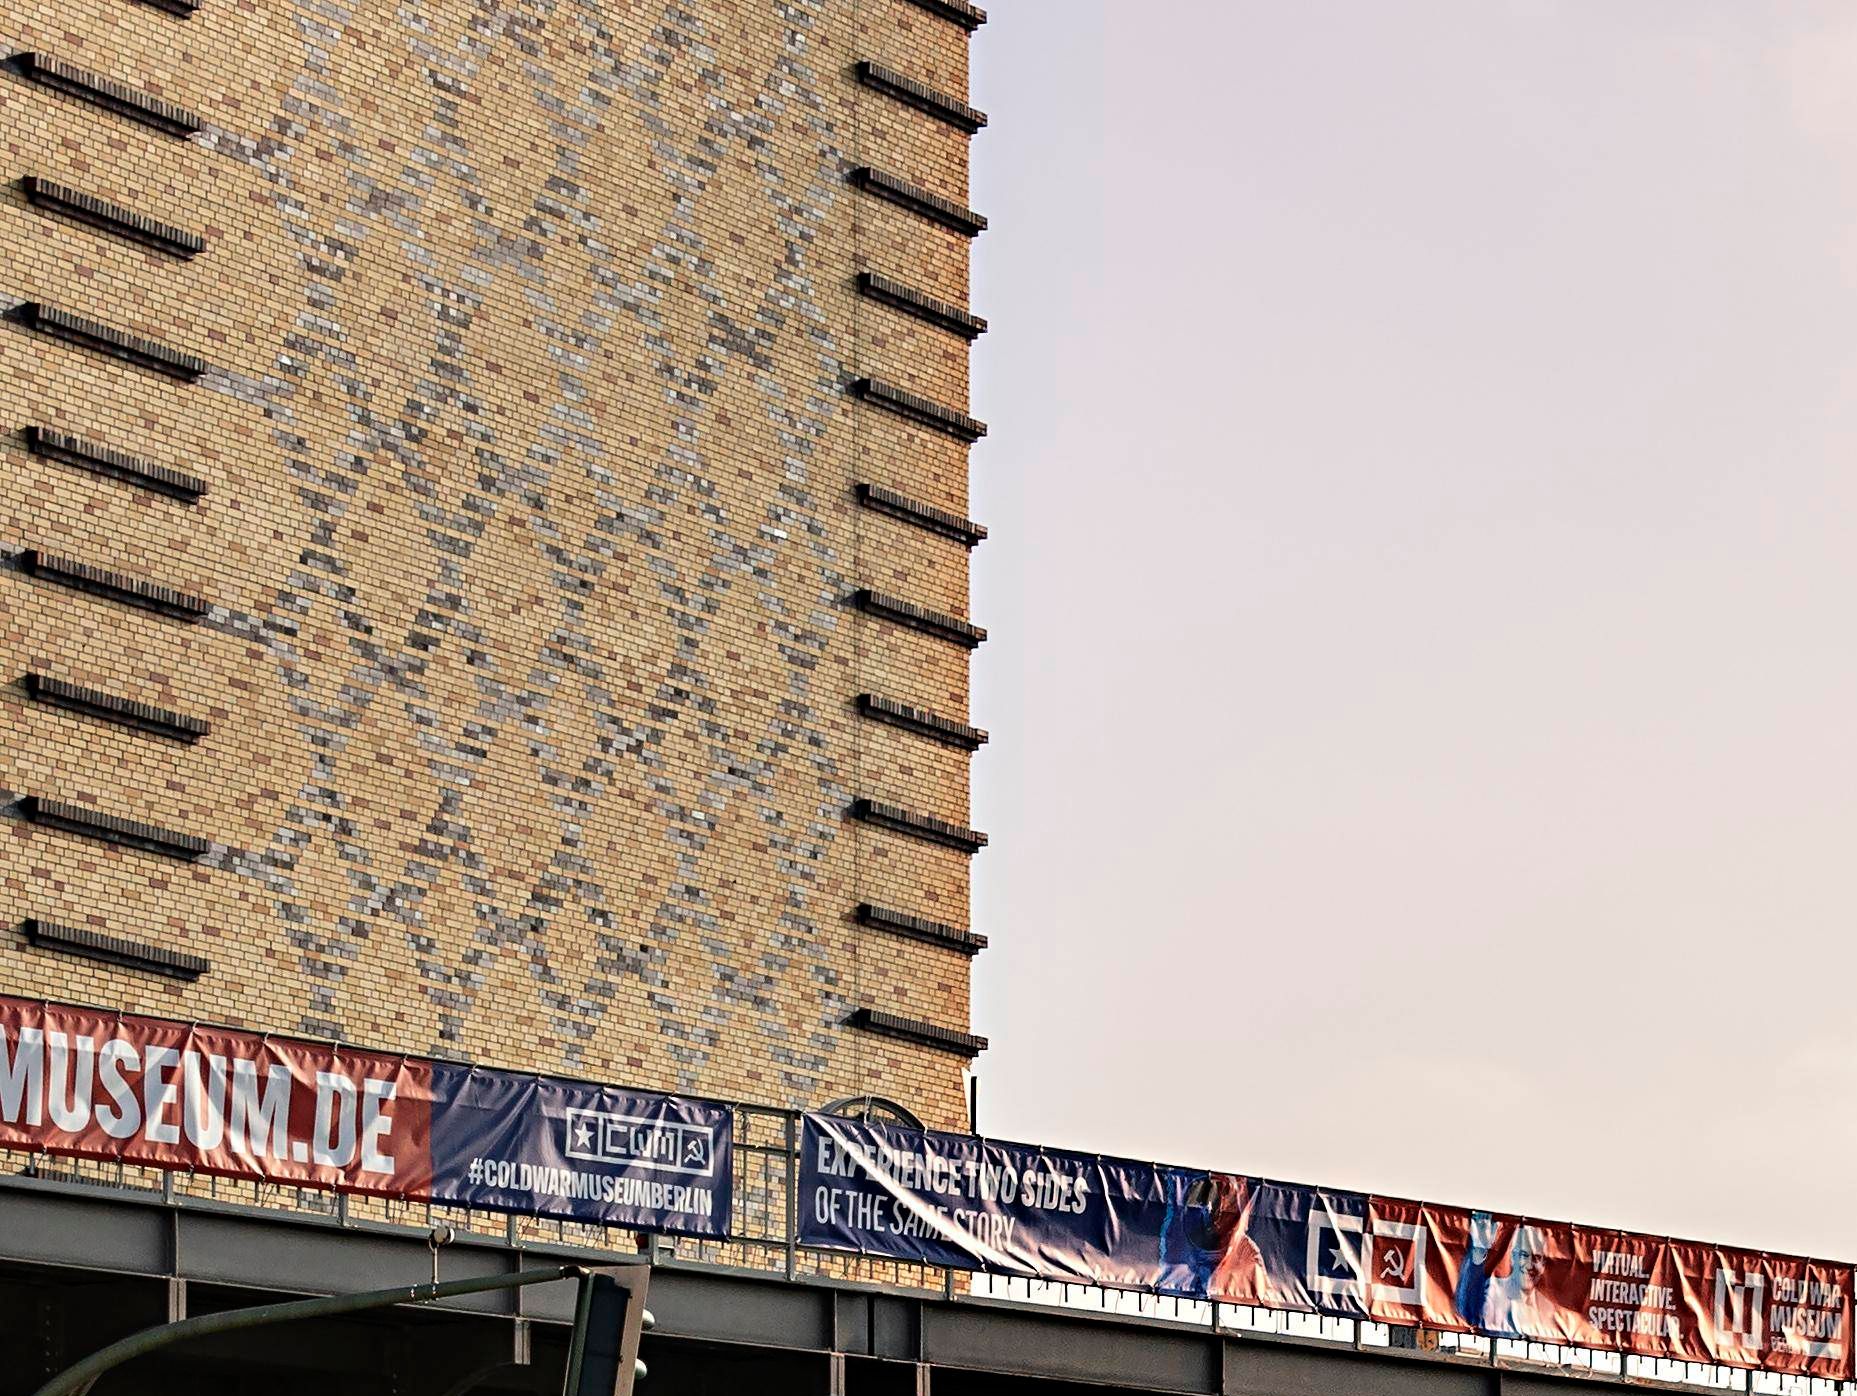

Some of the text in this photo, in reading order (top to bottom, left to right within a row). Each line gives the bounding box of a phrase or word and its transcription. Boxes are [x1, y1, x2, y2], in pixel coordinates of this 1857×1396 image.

[0, 1023, 396, 1175] MUSEUM.DE
[468, 1157, 712, 1217] #COLDWARMUSEUMBERLIN
[817, 1136, 1092, 1214] EXPERIENCE TWO SIDES
[814, 1185, 842, 1225] OF
[846, 1190, 888, 1232] THE
[952, 1208, 1015, 1248] STORY
[1590, 1278, 1676, 1311] INTERACTIVE.
[1770, 1304, 1842, 1340] MUSEUM
[1772, 1276, 1842, 1308] COLD WAR
